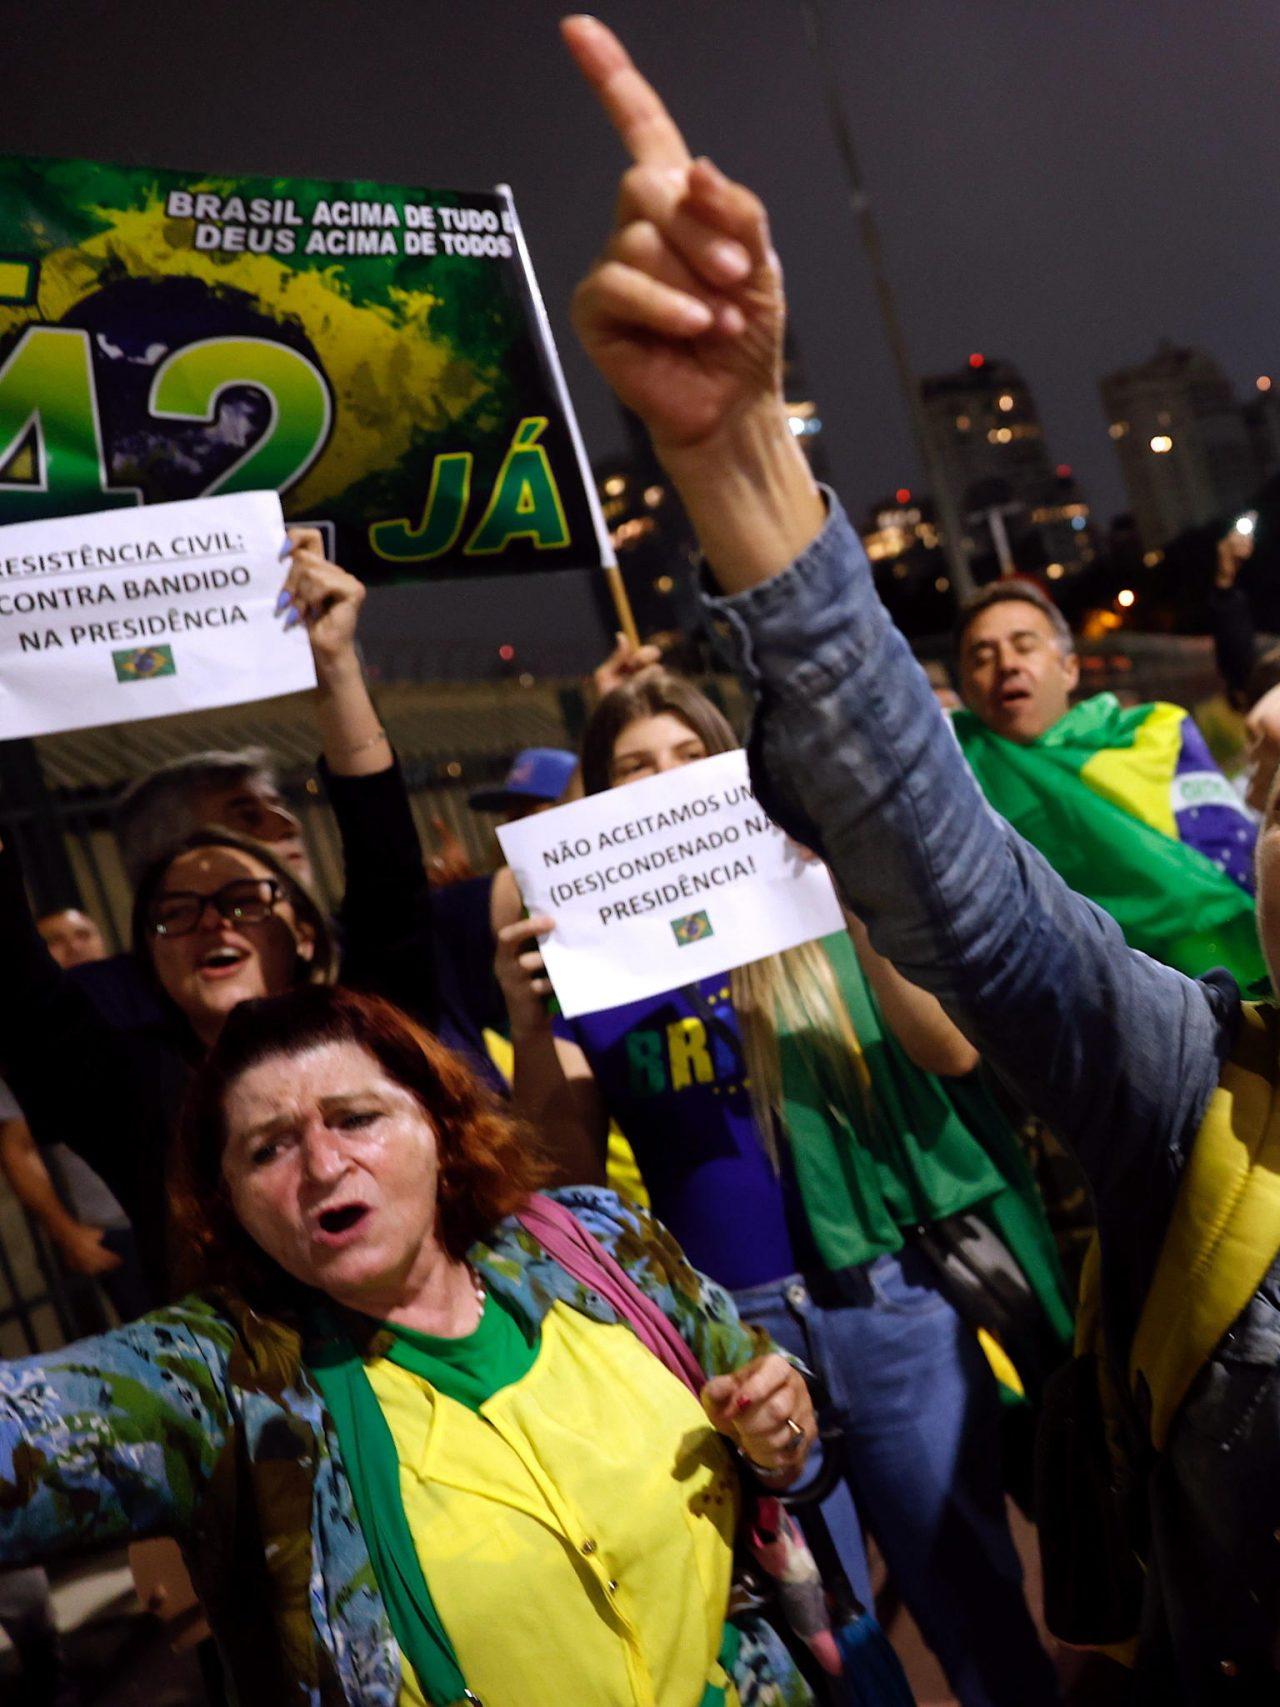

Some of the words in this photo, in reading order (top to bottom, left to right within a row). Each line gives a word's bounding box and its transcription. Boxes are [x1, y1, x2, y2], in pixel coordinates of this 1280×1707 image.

[167, 190, 303, 226] BRASIL
[312, 200, 400, 228] ACIMA
[404, 204, 437, 229] DE
[437, 206, 500, 233] TUDO
[195, 223, 296, 254] DEUS
[305, 229, 399, 255] ACIMA
[404, 230, 437, 256] DE
[438, 232, 514, 258] TODOS
[369, 416, 571, 562] JÁ
[171, 531, 244, 556] CIVIL:
[0, 583, 116, 616] CONTRA
[123, 565, 251, 600] BANDIDO
[19, 629, 64, 653] NA
[70, 605, 248, 646] PRESIDÊNCIA
[542, 838, 592, 868] NÃO
[598, 794, 721, 851] ACEITAMOS
[549, 825, 740, 908] (DES)CONDENADO
[598, 855, 758, 926] PRESIDÊNCIA!
